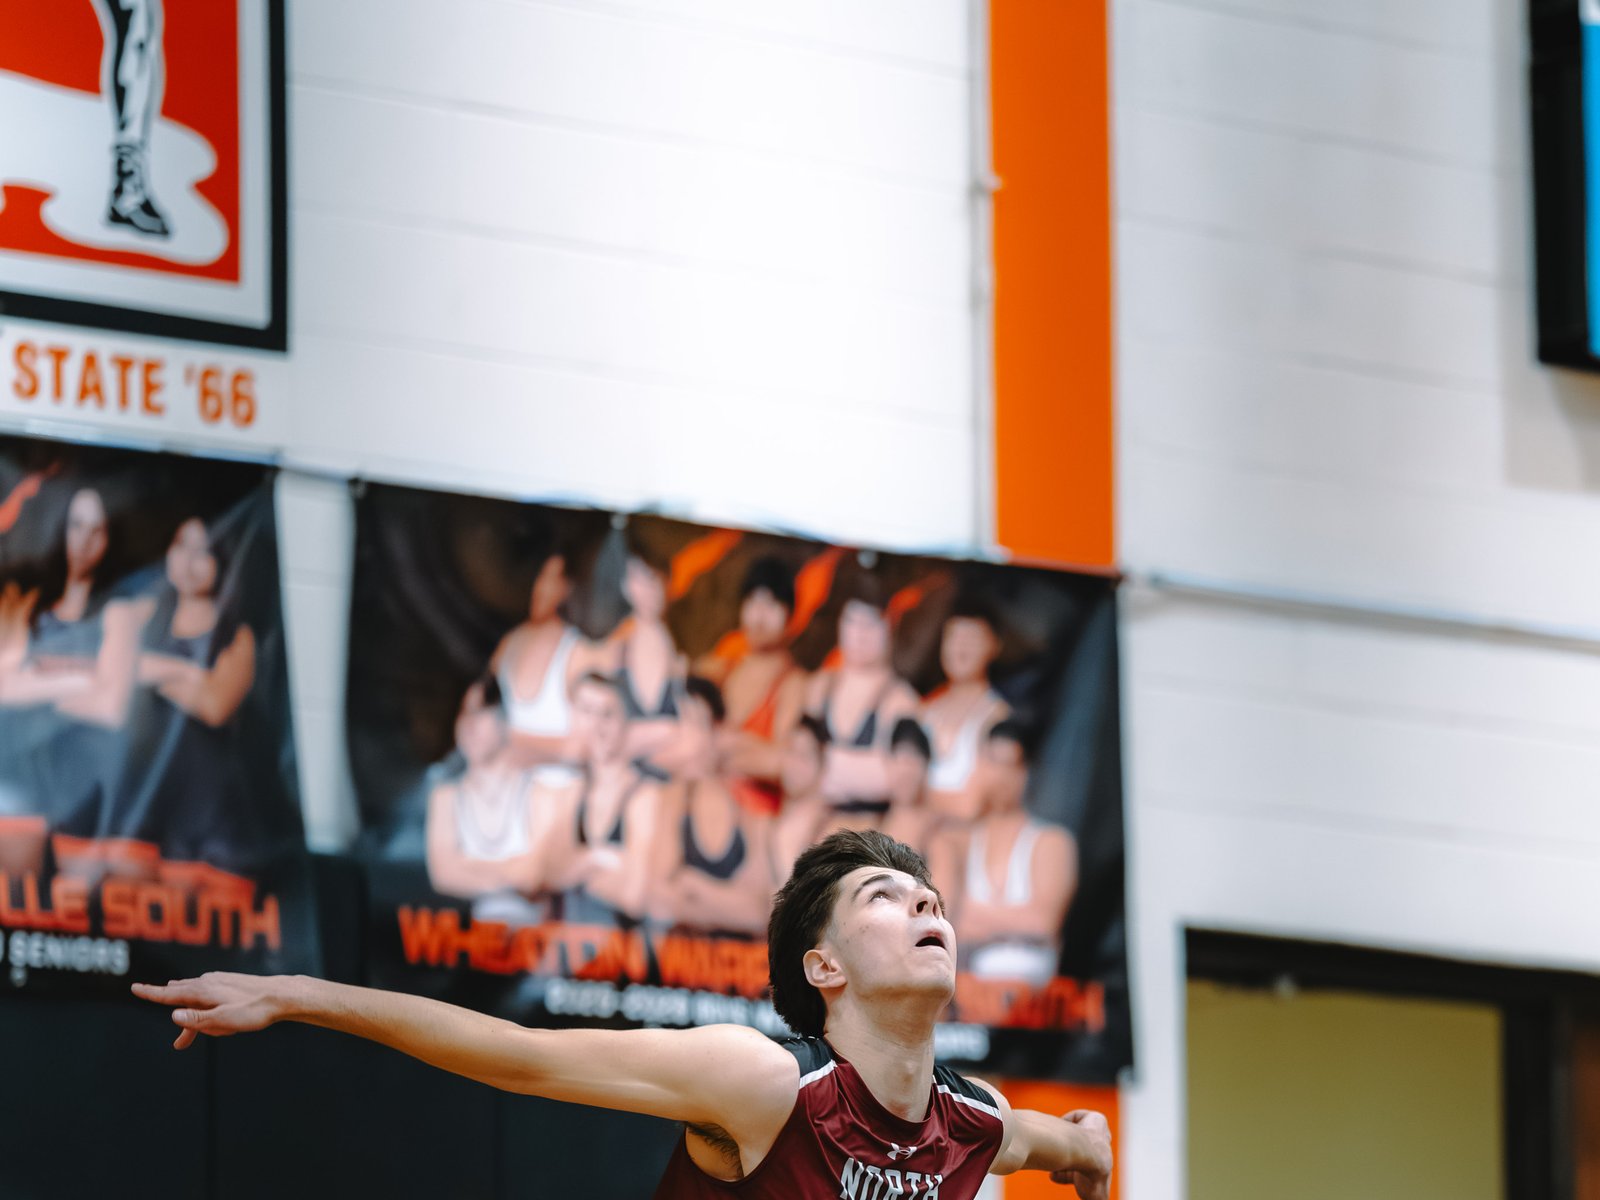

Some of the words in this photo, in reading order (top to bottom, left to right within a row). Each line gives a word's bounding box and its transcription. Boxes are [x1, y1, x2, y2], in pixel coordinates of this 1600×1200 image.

[13, 340, 165, 416] STATE
[185, 364, 257, 428] '66
[9, 930, 129, 974] SENIORS
[102, 876, 282, 954] SOUTH
[396, 904, 649, 984] WHEATON
